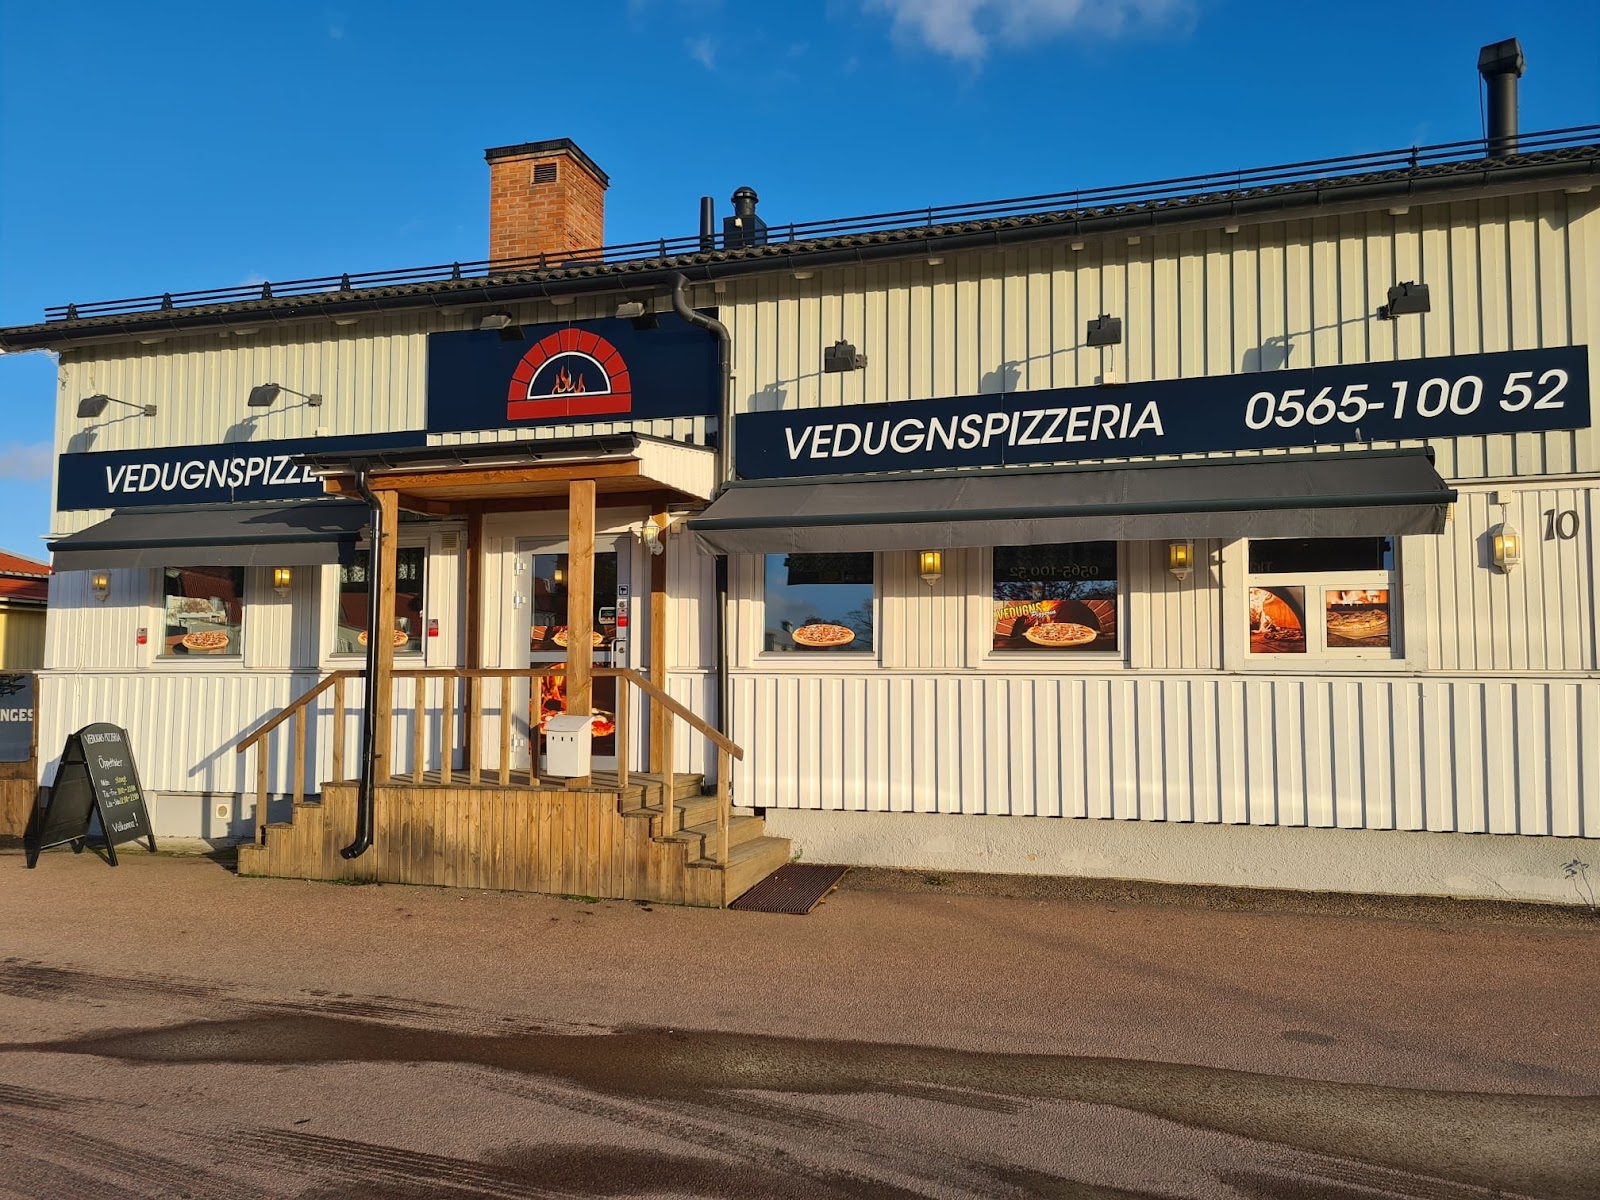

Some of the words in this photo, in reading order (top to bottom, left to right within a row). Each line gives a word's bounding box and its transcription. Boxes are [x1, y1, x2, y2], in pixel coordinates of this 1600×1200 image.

[1245, 375, 1484, 430] 0565-100
[1499, 369, 1568, 412] 52
[785, 401, 1164, 460] VEDUGNSPIZZERIA
[1543, 508, 1580, 542] 10
[996, 602, 1043, 620] VEDUGNS
